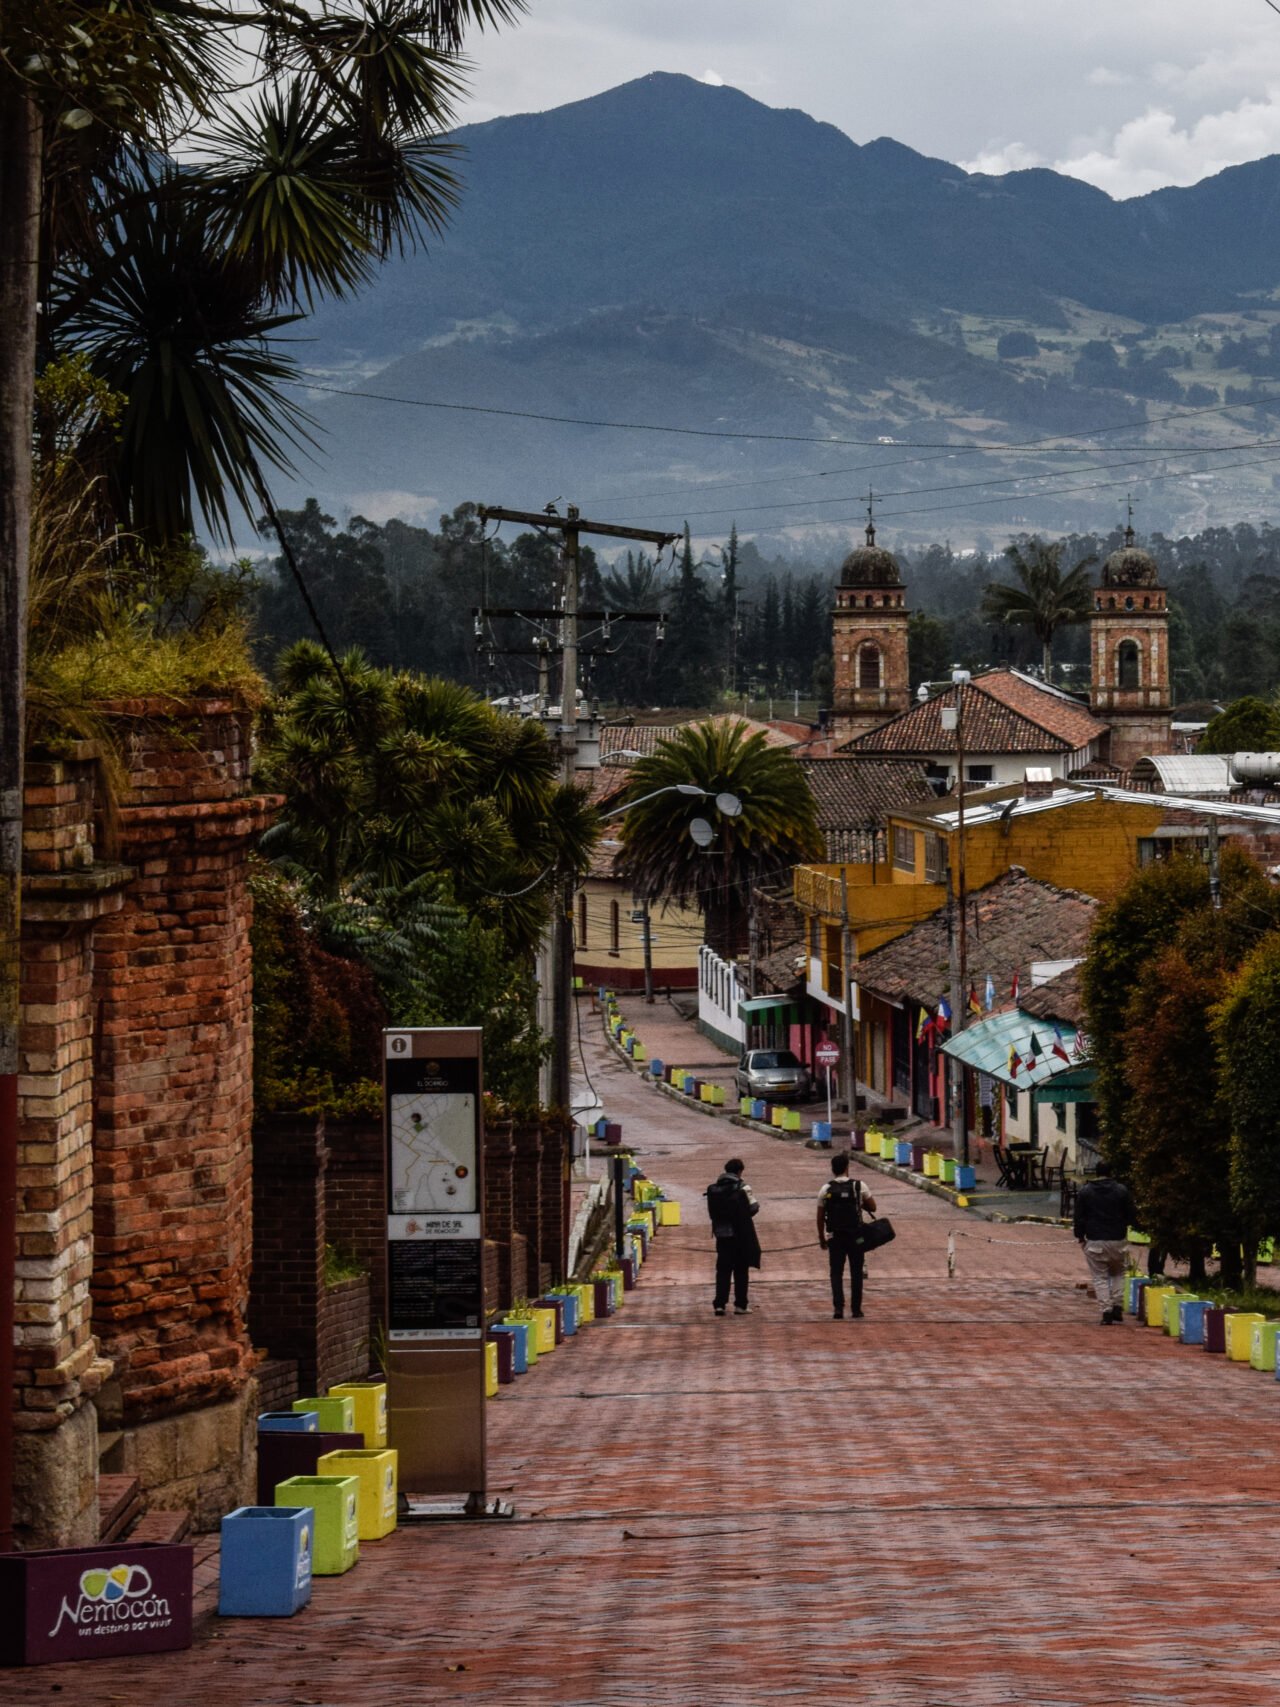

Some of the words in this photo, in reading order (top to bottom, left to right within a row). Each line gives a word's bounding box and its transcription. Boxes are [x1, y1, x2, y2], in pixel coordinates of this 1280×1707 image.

[442, 1220, 450, 1228] DE
[48, 1593, 171, 1637] Nemocón
[78, 1627, 92, 1637] un
[94, 1623, 130, 1635] destino
[132, 1621, 148, 1631] por
[150, 1618, 173, 1629] vivir
